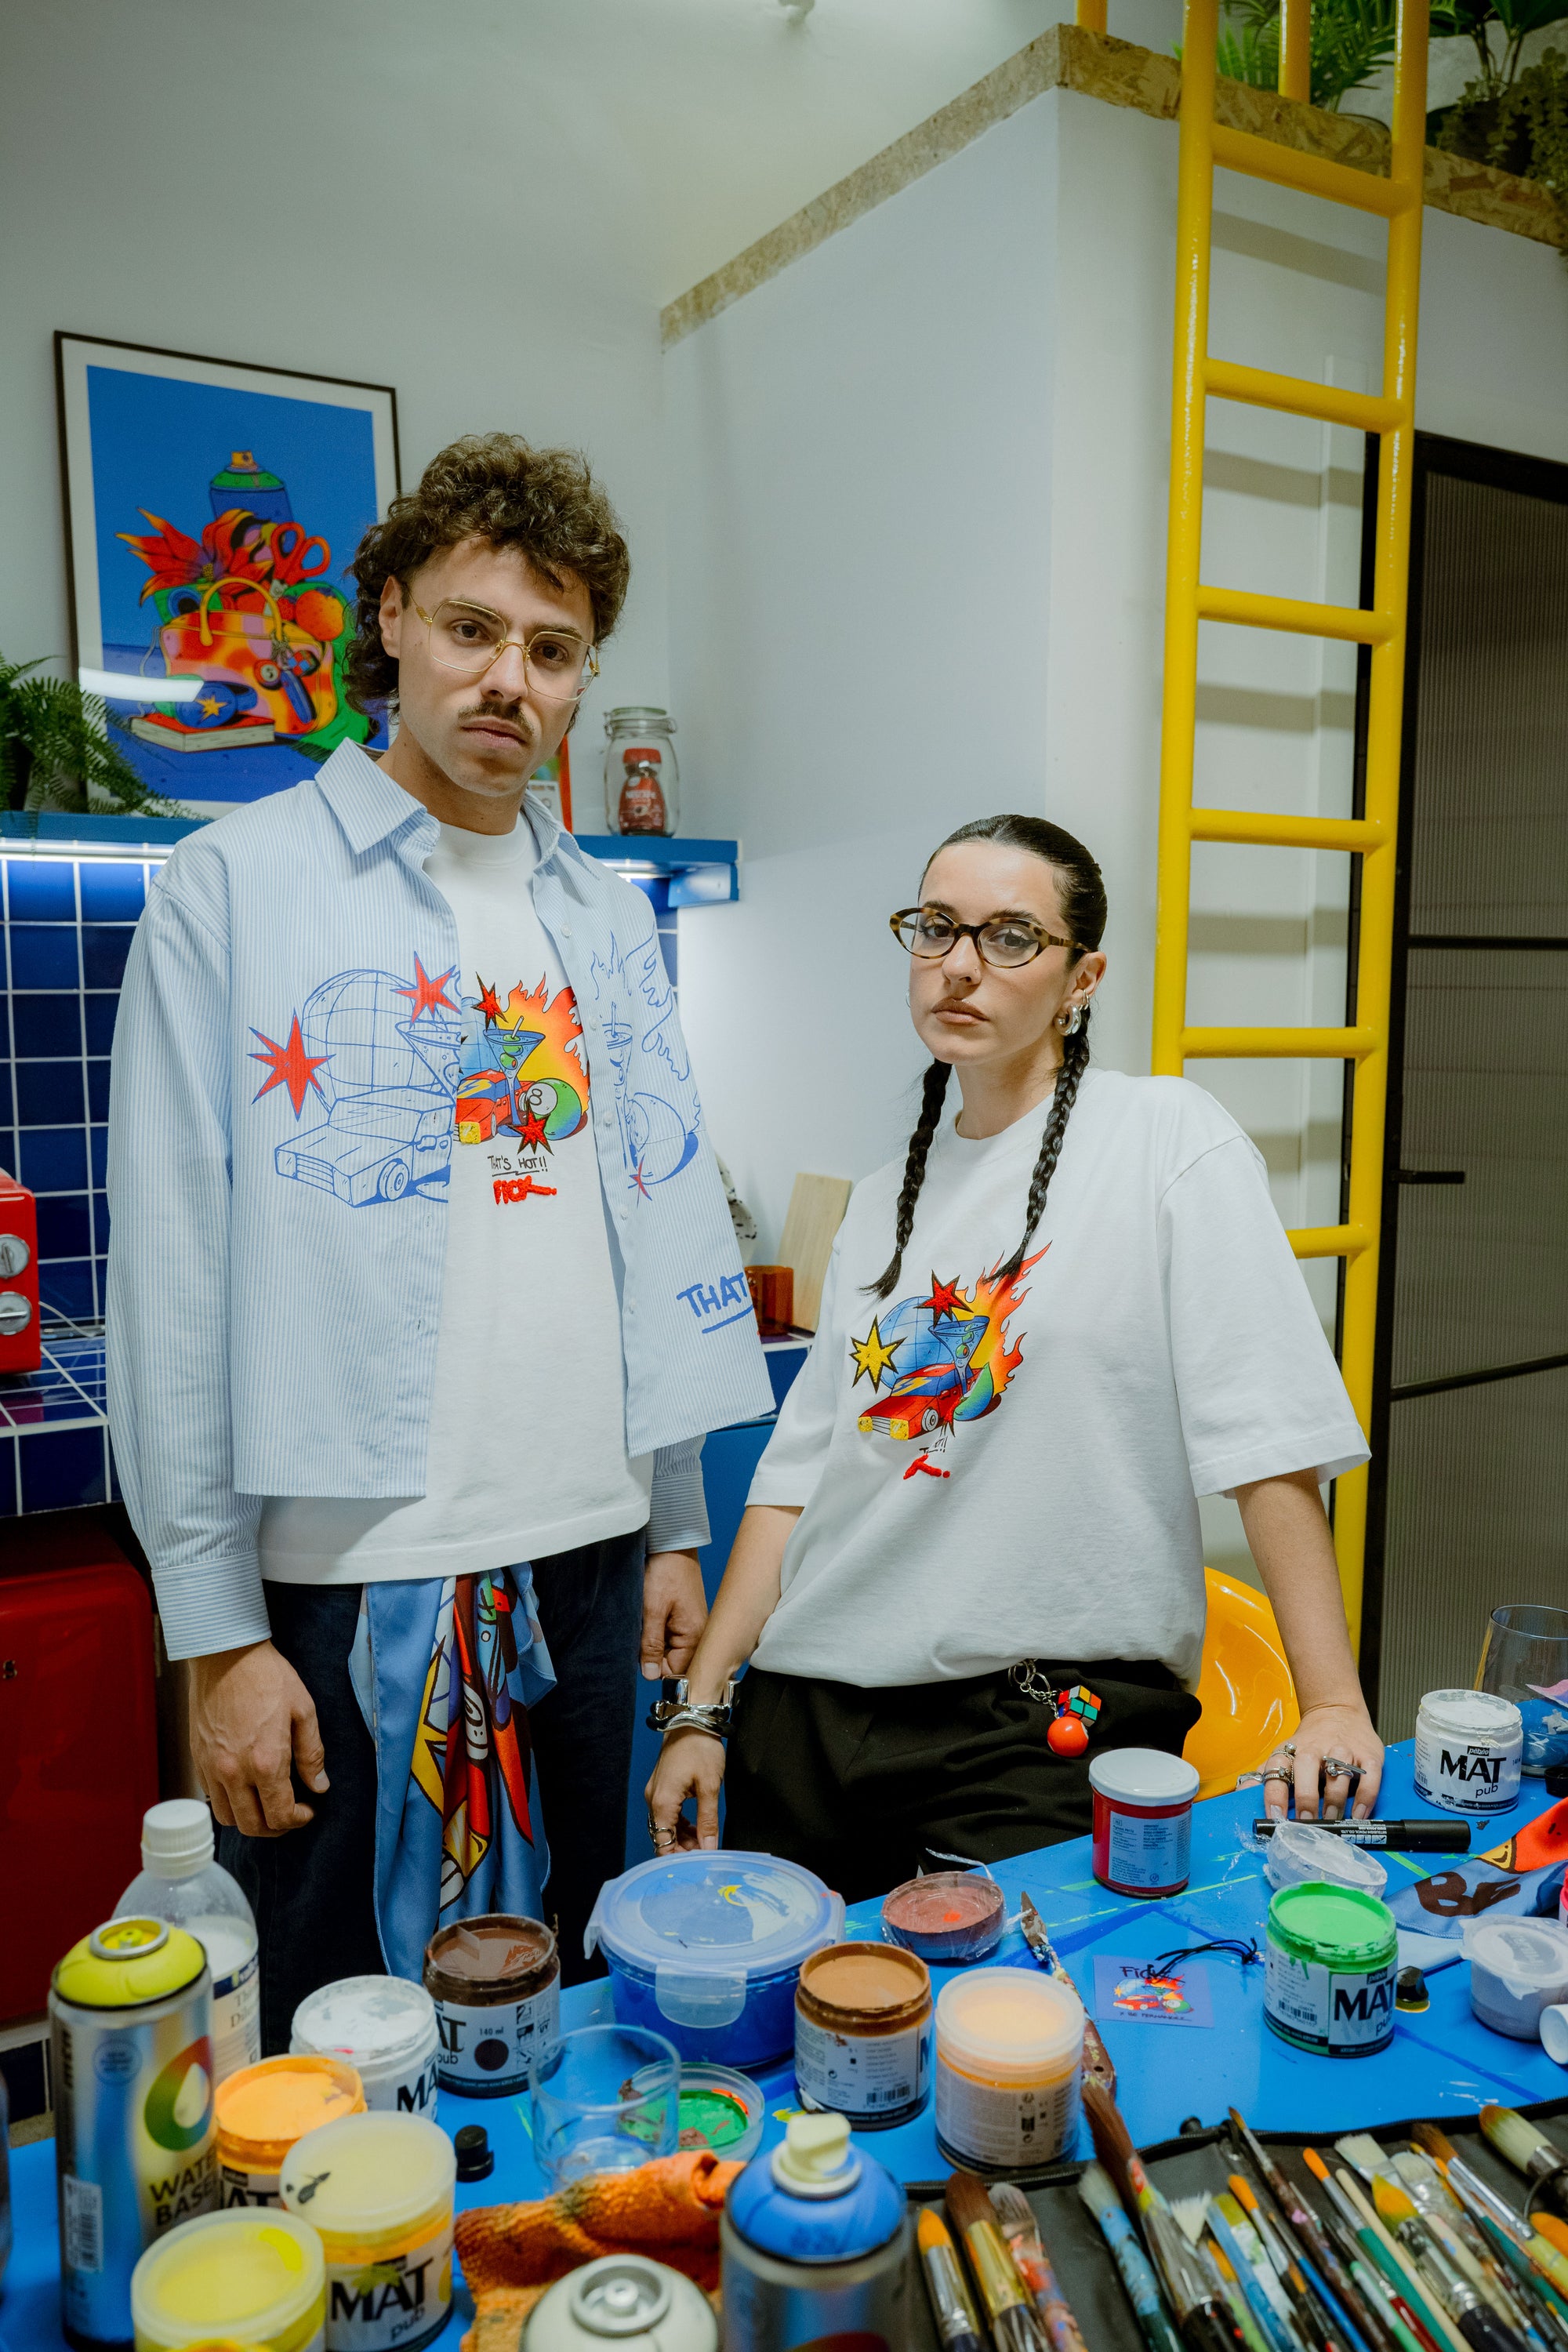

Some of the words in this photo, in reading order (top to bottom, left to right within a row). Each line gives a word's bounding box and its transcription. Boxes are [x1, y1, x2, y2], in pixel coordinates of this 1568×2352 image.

[518, 1156, 548, 1172] HOT!!
[676, 1272, 747, 1318] THAT
[1440, 1749, 1506, 1784] MAT
[1475, 1782, 1498, 1798] pub
[397, 2061, 438, 2113] MA
[332, 2257, 434, 2322] MAT
